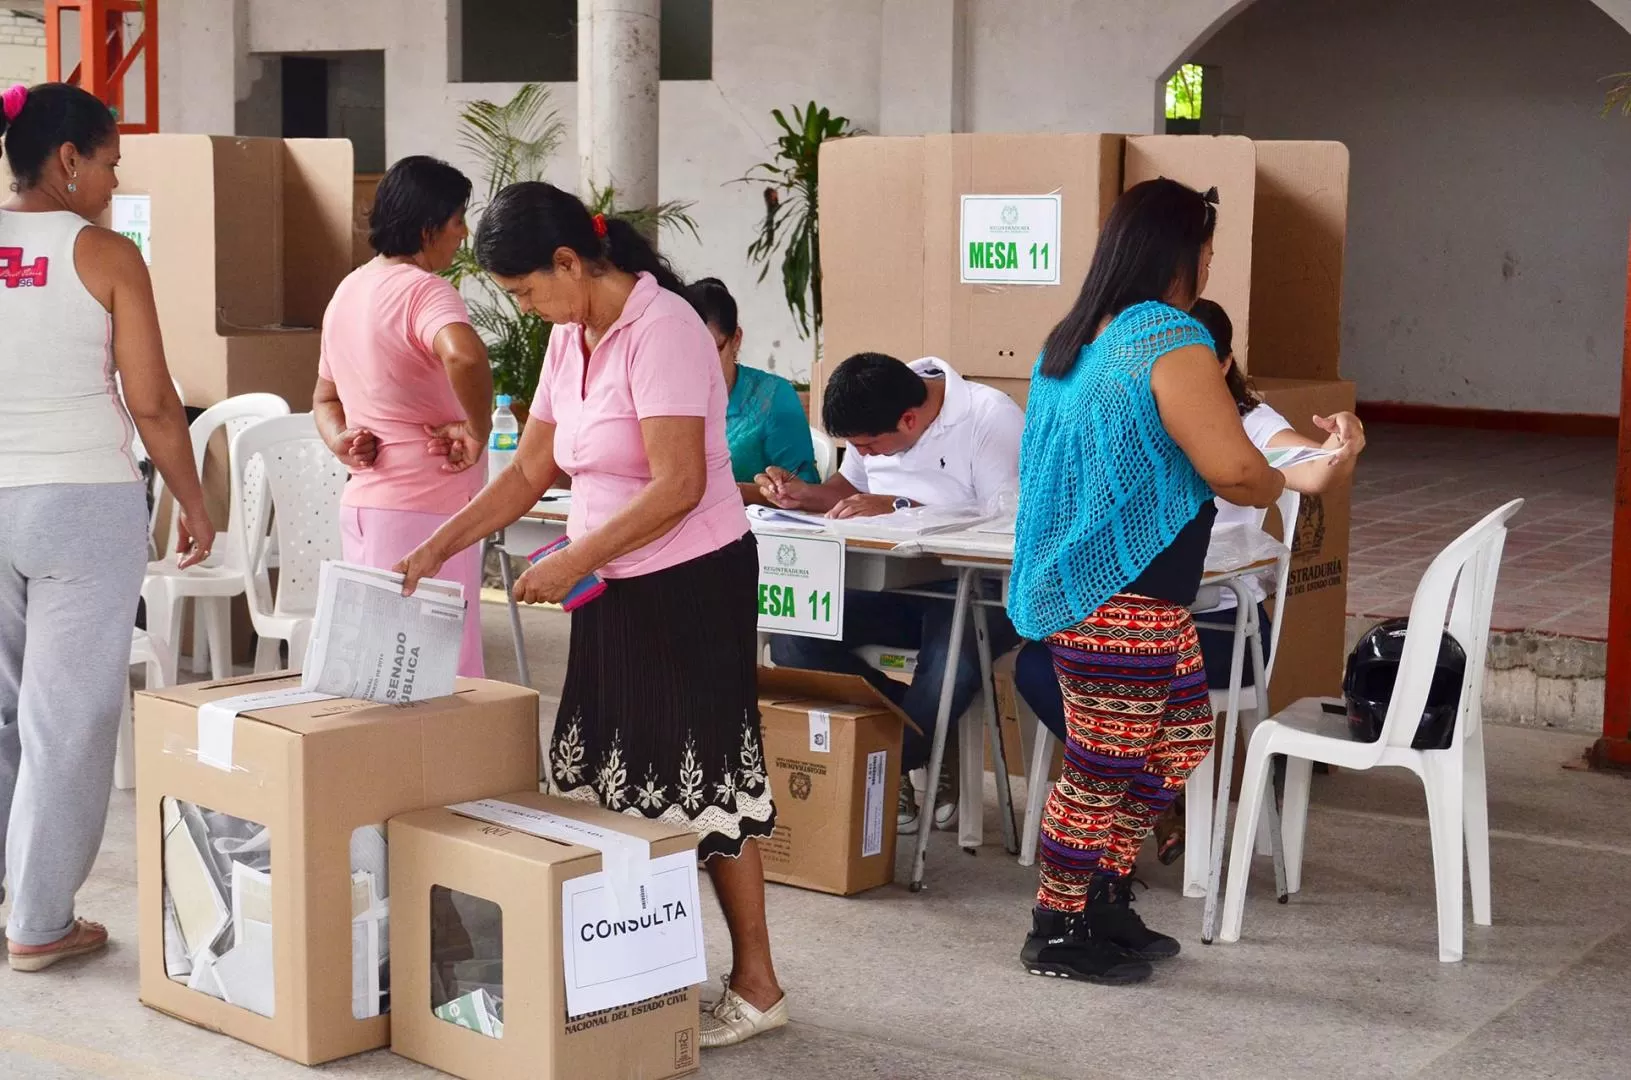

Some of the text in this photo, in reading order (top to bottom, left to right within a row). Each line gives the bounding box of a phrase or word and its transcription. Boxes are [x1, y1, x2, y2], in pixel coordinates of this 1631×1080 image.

[969, 242, 1049, 270] MESA 11
[758, 583, 831, 622] ESA 11
[386, 632, 407, 700] SENADO
[580, 901, 687, 942] CONSULTA
[565, 993, 689, 1035] NACIONAL DEL ESTADO CIVIL
